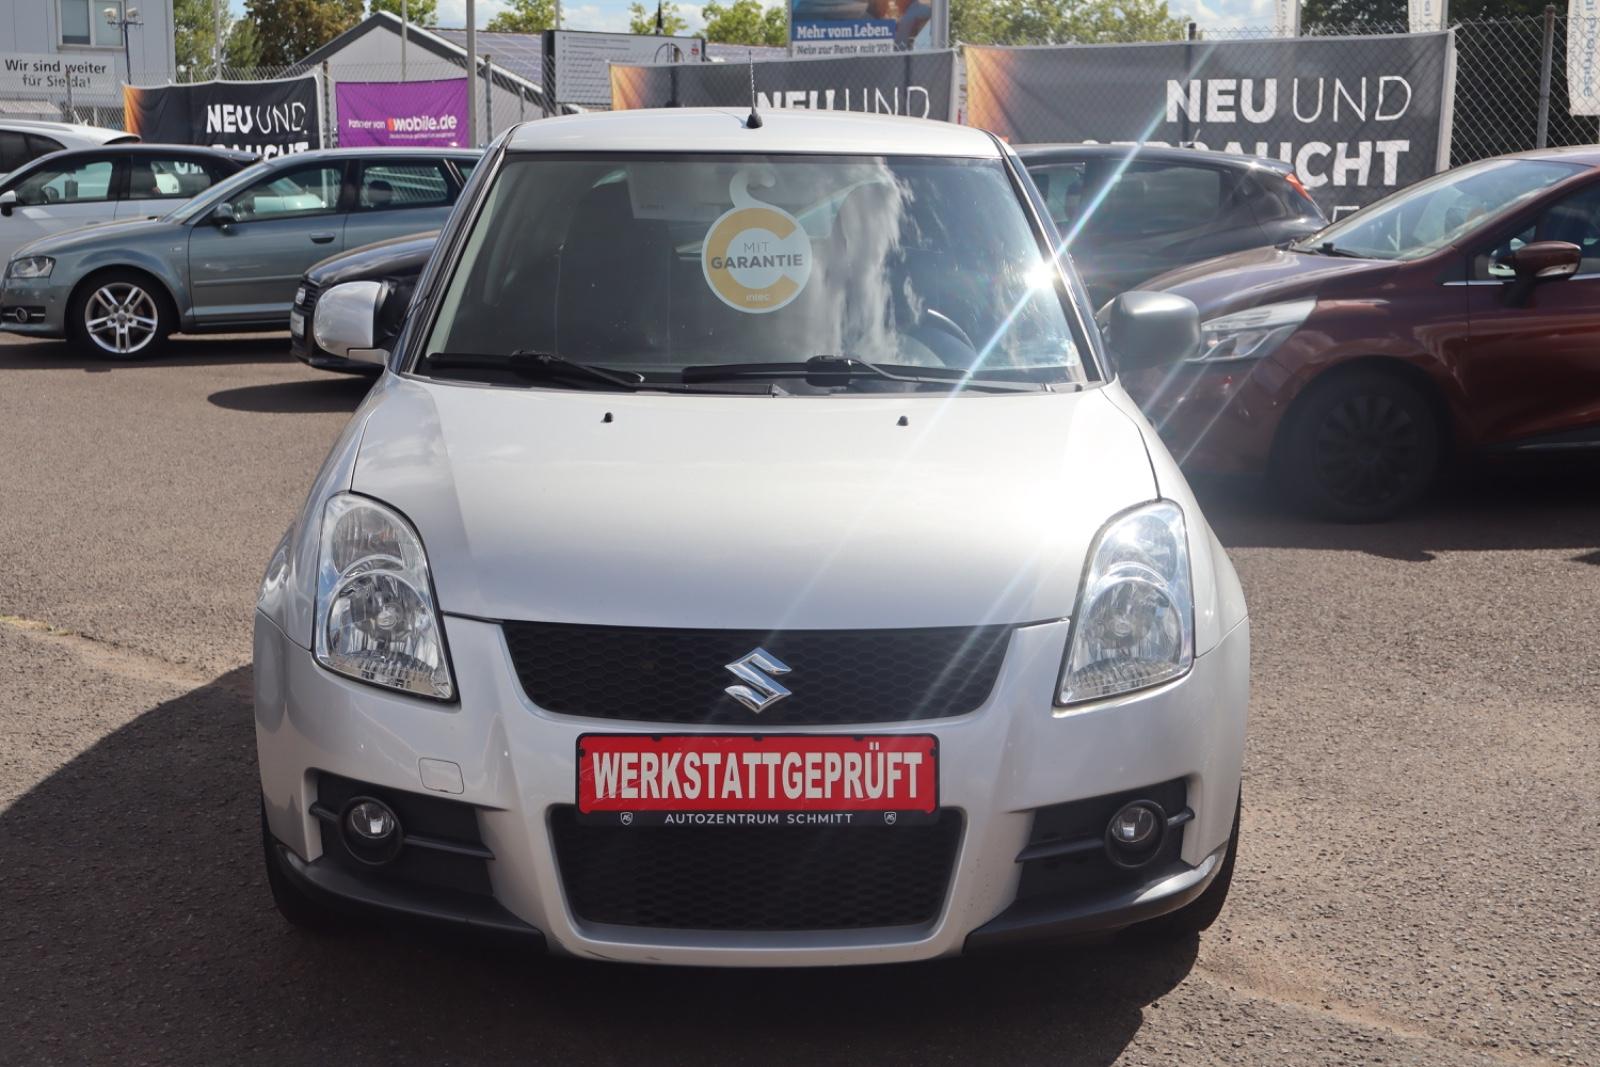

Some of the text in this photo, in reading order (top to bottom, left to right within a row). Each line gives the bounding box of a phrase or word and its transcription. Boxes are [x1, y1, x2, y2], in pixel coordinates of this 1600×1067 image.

[797, 22, 893, 39] Mehr vom Leben.
[797, 45, 817, 55] Nein
[5, 59, 107, 74] Wir sind weiter
[22, 74, 42, 86] für
[47, 74, 65, 87] Sie
[1166, 75, 1412, 124] NEU UND
[206, 101, 306, 134] NEU UND
[392, 114, 458, 132] mobile.de
[743, 241, 769, 253] MIT
[710, 253, 803, 269] GARANTIE
[592, 741, 923, 800] WERKSTATTGEPRÜFT
[664, 812, 854, 825] AUTOZENTRUM SCHMITT
